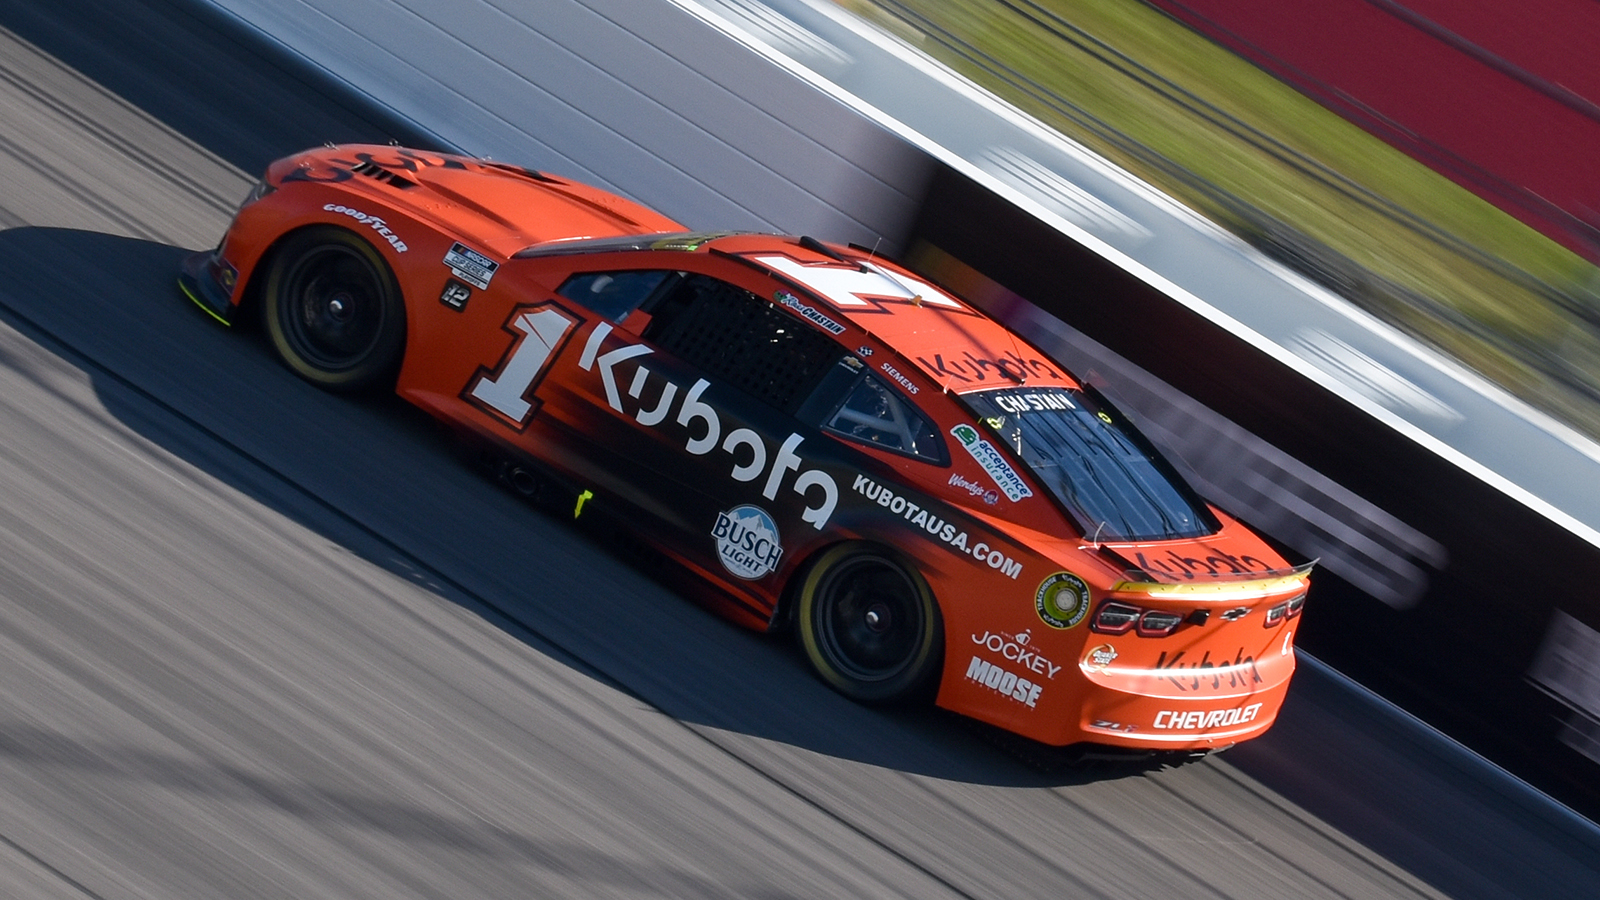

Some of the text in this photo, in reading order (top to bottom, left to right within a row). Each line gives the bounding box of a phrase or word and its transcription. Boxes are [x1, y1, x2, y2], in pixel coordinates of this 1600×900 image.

[323, 203, 408, 253] GOODYEAR
[802, 306, 846, 335] CHASTAIN
[468, 305, 576, 425] 1
[880, 362, 920, 395] SIEMENS
[916, 350, 1063, 382] Kubota
[578, 321, 839, 530] Kubota
[948, 473, 985, 496] Wendy's
[970, 446, 1019, 500] insurance
[979, 441, 1028, 495] acceptance
[712, 514, 782, 569] BUSCH
[852, 474, 1023, 580] KUBOTAUSA.COM
[722, 544, 763, 572] LIGHT
[971, 630, 1062, 679] JOCKEY
[966, 655, 1043, 708] MOOSE
[1153, 702, 1263, 730] CHEVROLET
